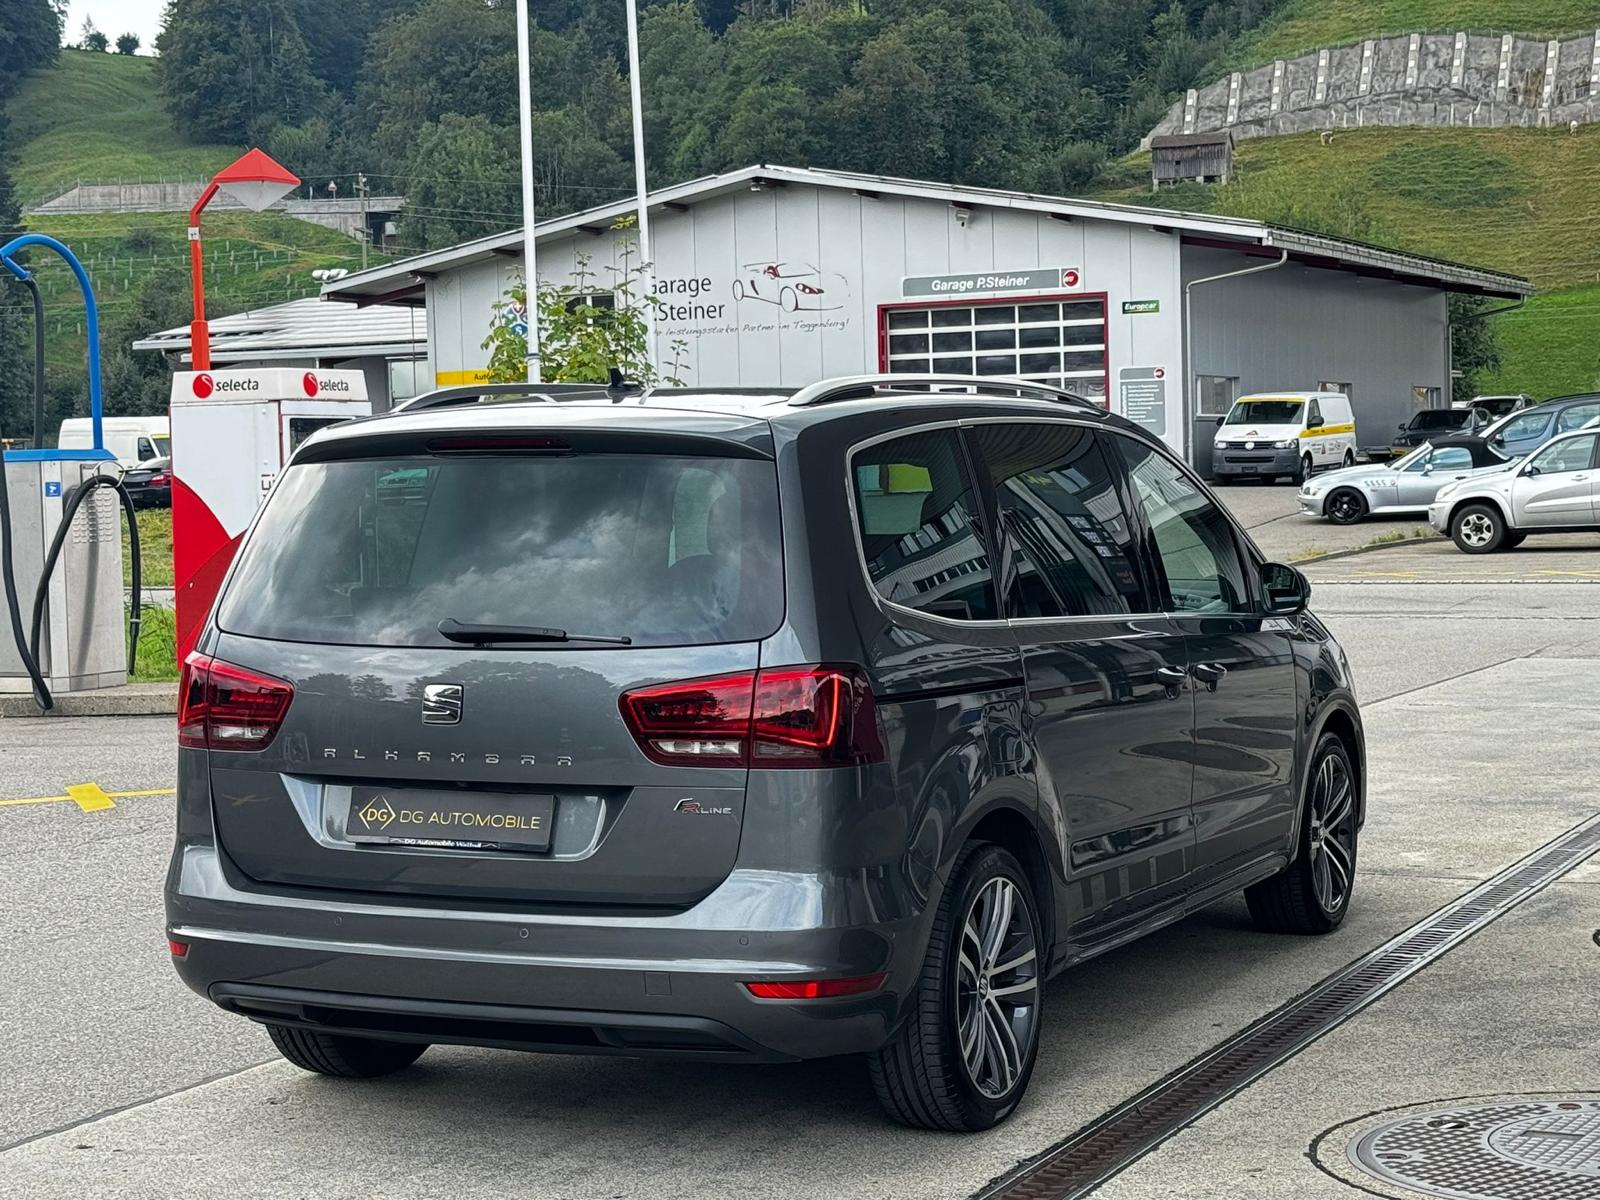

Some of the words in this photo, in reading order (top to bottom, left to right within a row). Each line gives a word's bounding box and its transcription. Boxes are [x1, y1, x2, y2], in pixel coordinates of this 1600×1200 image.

[931, 279, 974, 292] Garage
[976, 275, 1030, 289] P.Steiner
[652, 301, 726, 322] .Steiner
[1125, 302, 1158, 311] Europcar
[743, 323, 775, 332] Partner
[779, 322, 790, 330] im
[793, 318, 850, 332] Toggenburg!
[215, 378, 259, 392] selecta
[319, 378, 349, 392] selecta
[323, 747, 573, 767] ALHAMBRA
[366, 808, 389, 823] DG
[399, 810, 425, 824] DG
[427, 811, 542, 830] AUTOMOBILE
[417, 839, 455, 847] Automobile
